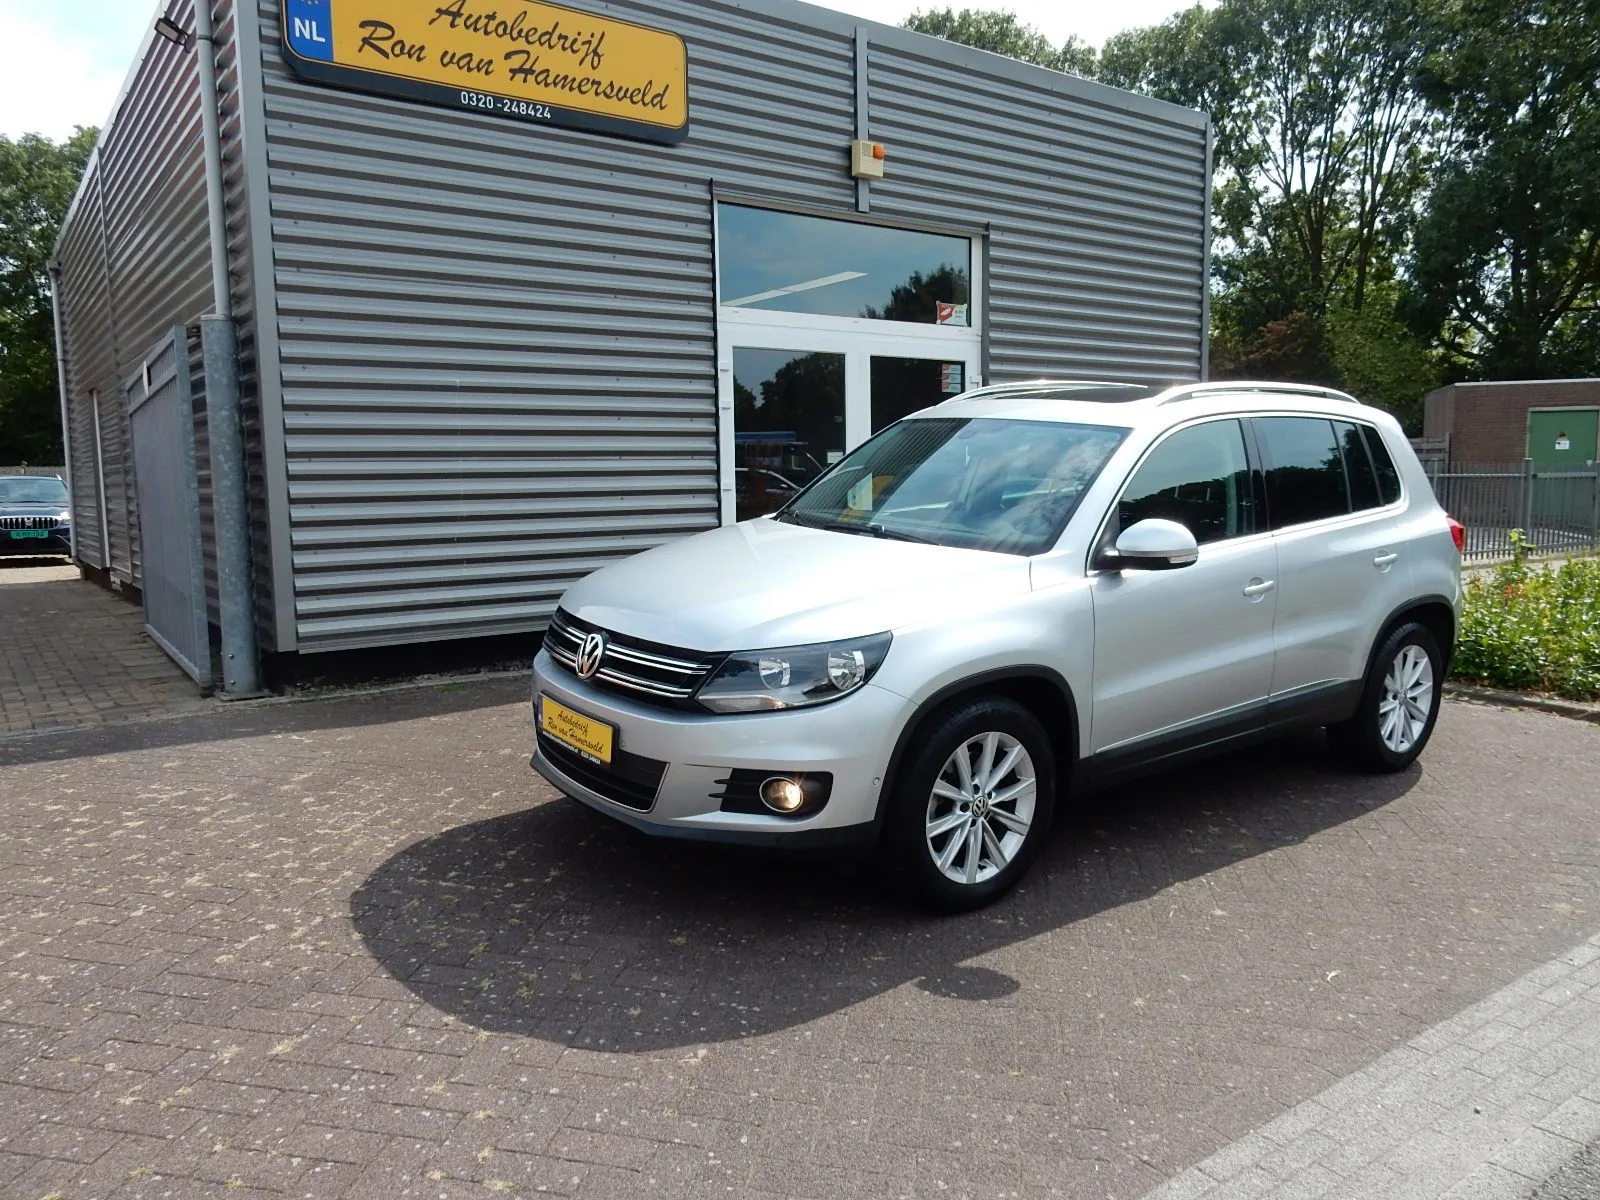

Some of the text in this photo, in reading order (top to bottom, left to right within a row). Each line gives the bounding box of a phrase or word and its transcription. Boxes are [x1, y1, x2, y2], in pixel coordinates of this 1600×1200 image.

[294, 17, 326, 43] NL
[358, 20, 670, 110] Ron van Hamersveld
[428, 0, 606, 70] Autobedrijf
